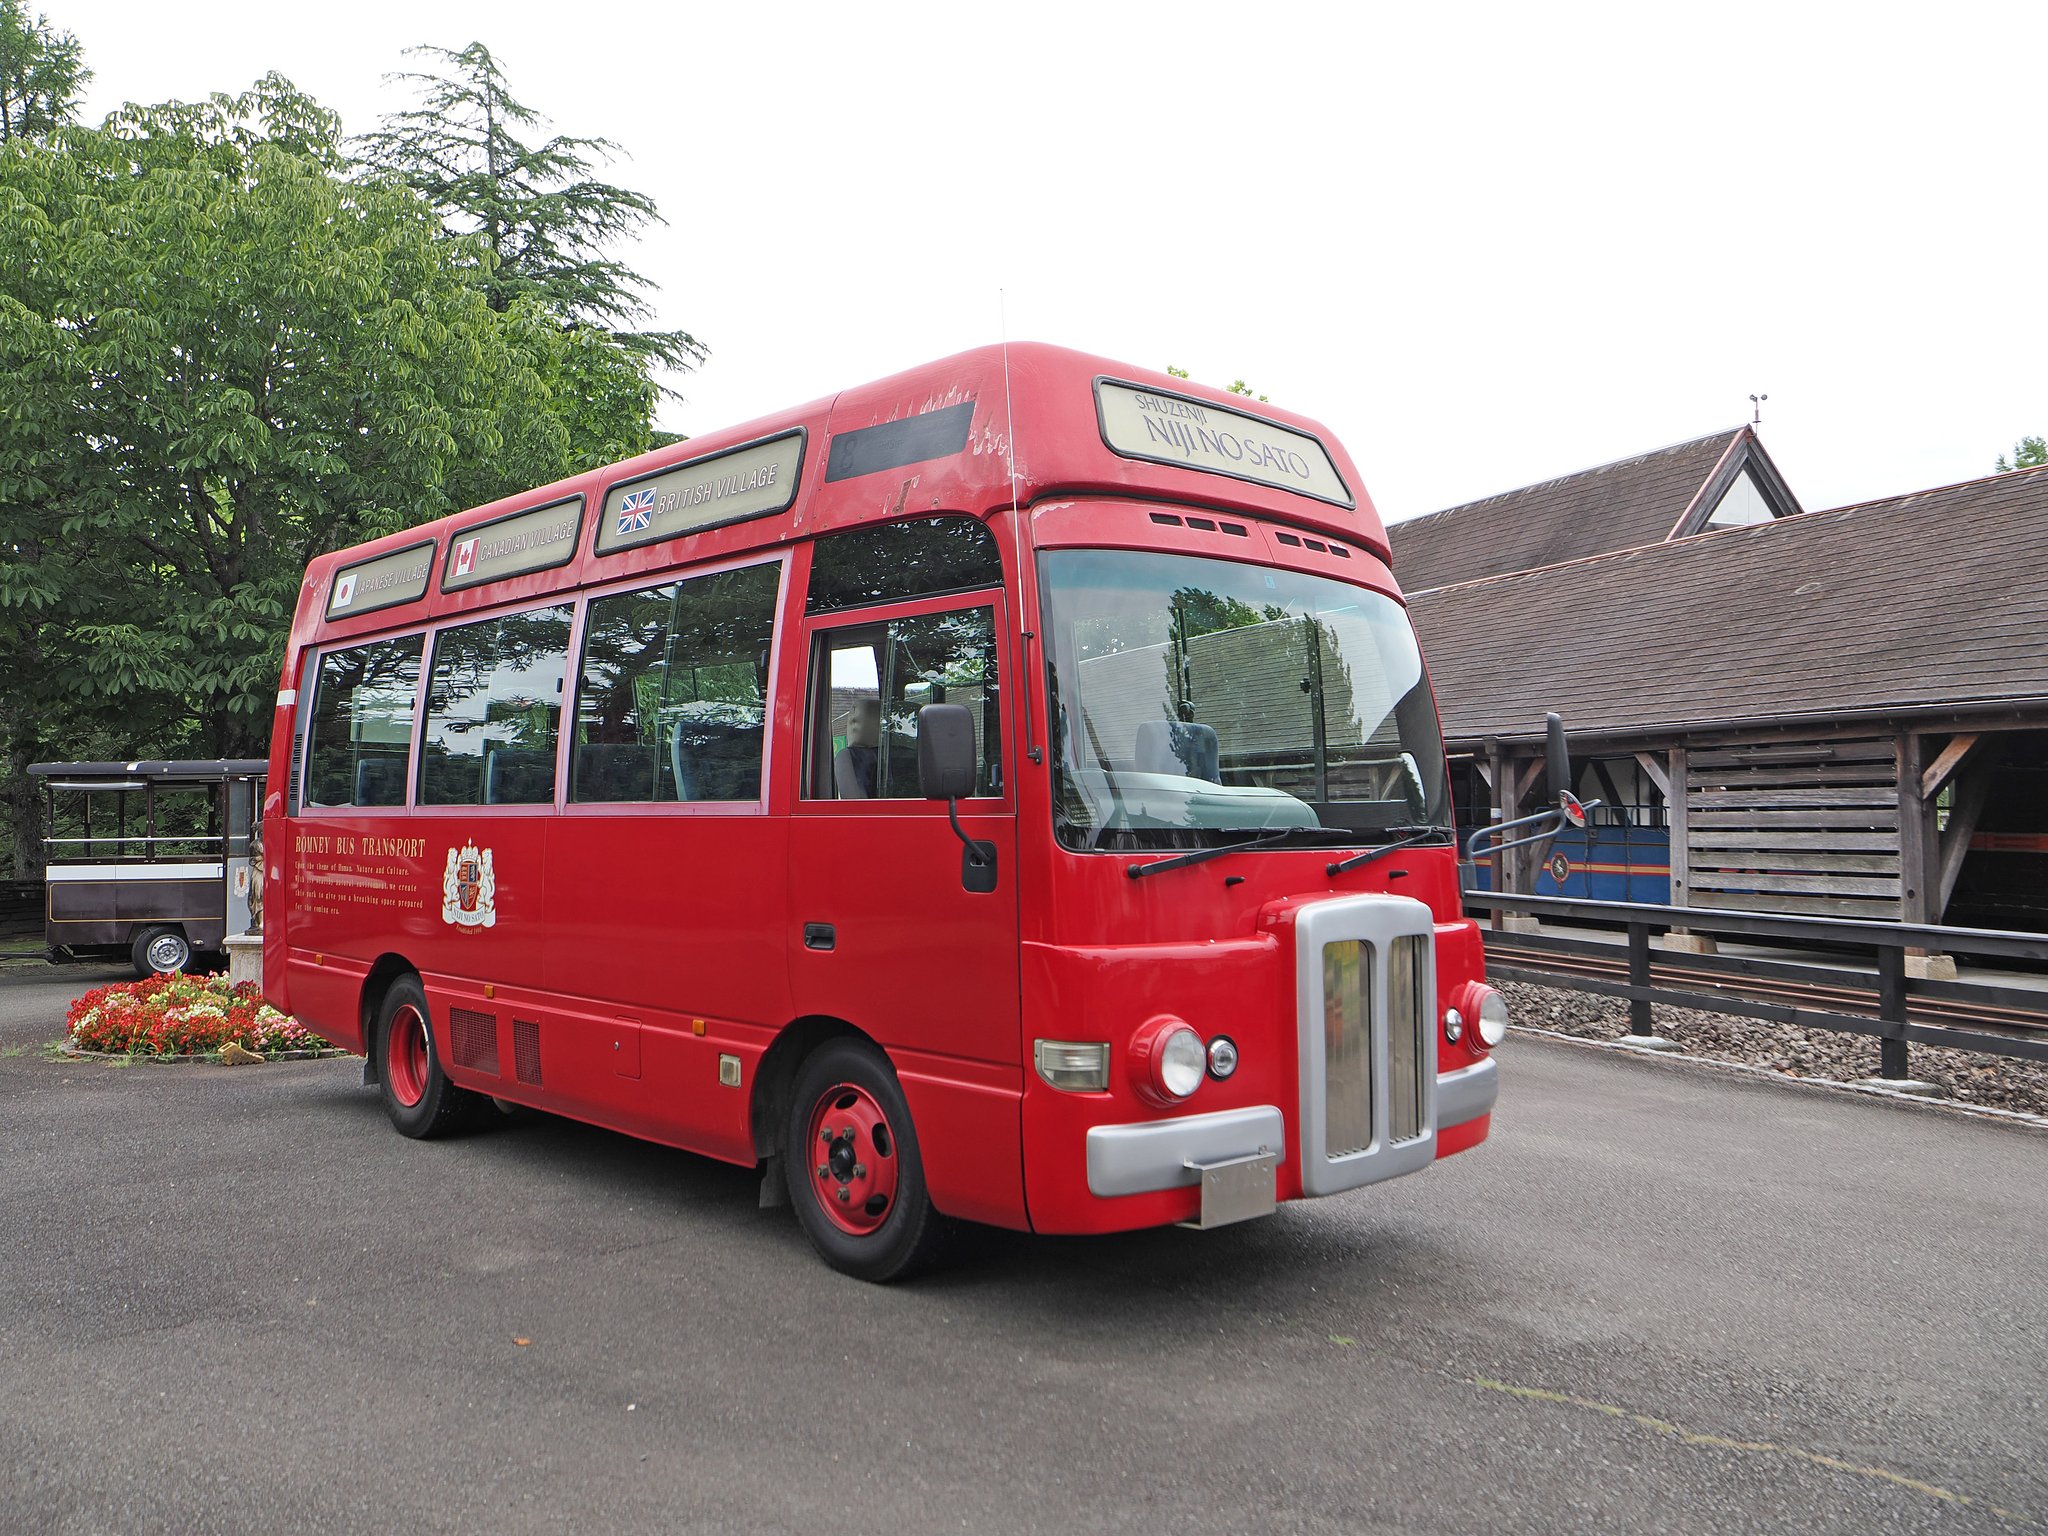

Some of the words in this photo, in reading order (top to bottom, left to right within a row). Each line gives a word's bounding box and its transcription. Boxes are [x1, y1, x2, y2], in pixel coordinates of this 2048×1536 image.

[1134, 394, 1207, 426] SHUZENJI
[1142, 414, 1198, 457] NIJI
[1198, 426, 1243, 461] NO
[1243, 438, 1310, 480] SATO
[657, 481, 714, 515] BRITISH
[716, 463, 778, 499] VILLAGE
[479, 536, 529, 562] CANADIAN
[529, 519, 576, 548] VILLAGE
[354, 573, 394, 597] JAPANESE
[394, 561, 429, 586] VILLAGE
[295, 836, 331, 854] ROMNEY
[336, 836, 355, 855] BUS
[362, 837, 426, 858] TRANSPORT
[330, 863, 337, 872] of
[356, 864, 373, 874] Nature
[375, 866, 385, 875] and
[389, 883, 396, 891] we
[398, 884, 417, 892] create
[398, 899, 423, 909] prepared
